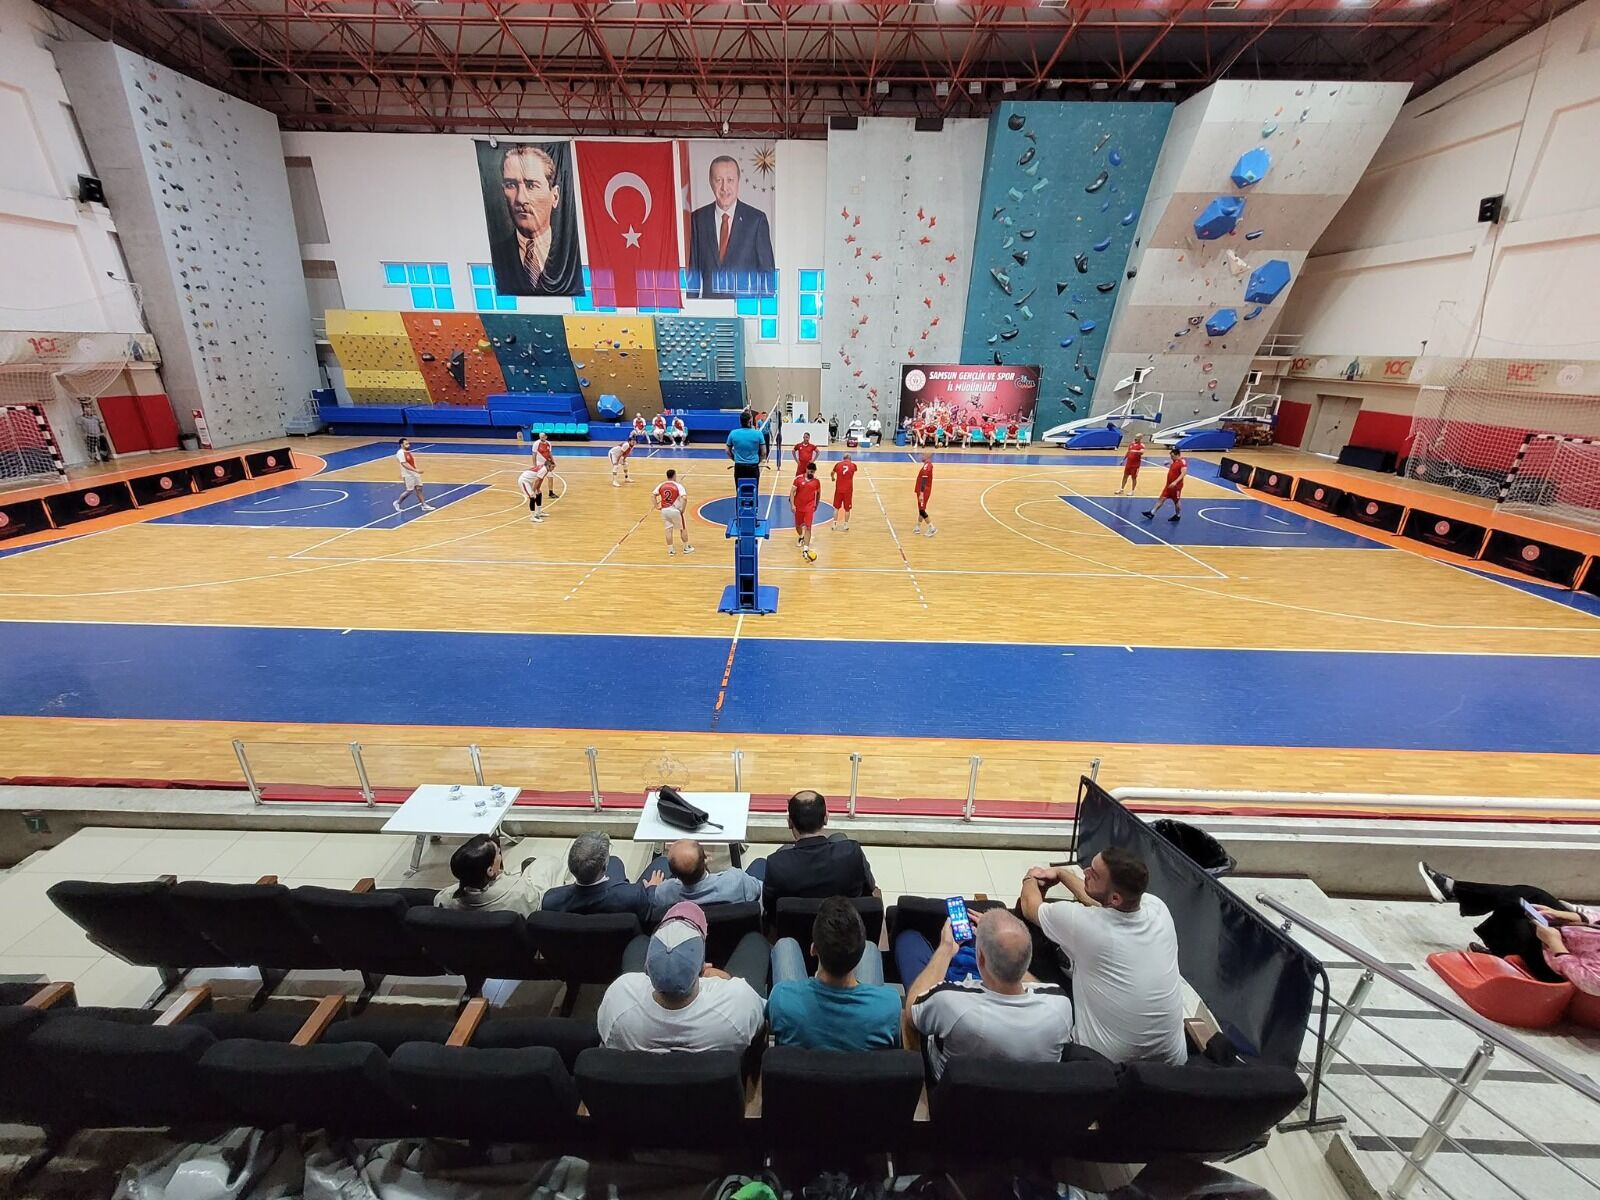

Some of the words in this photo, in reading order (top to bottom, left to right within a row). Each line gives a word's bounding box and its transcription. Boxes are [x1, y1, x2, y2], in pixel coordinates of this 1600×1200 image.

[929, 371, 957, 380] SAMSUN
[958, 370, 986, 381] GENÇLİK
[987, 372, 996, 380] VE
[997, 372, 1015, 380] SPOR
[947, 381, 954, 391] İL
[955, 382, 997, 392] MÜDÜRLÜĞÜ
[665, 490, 672, 502] 2
